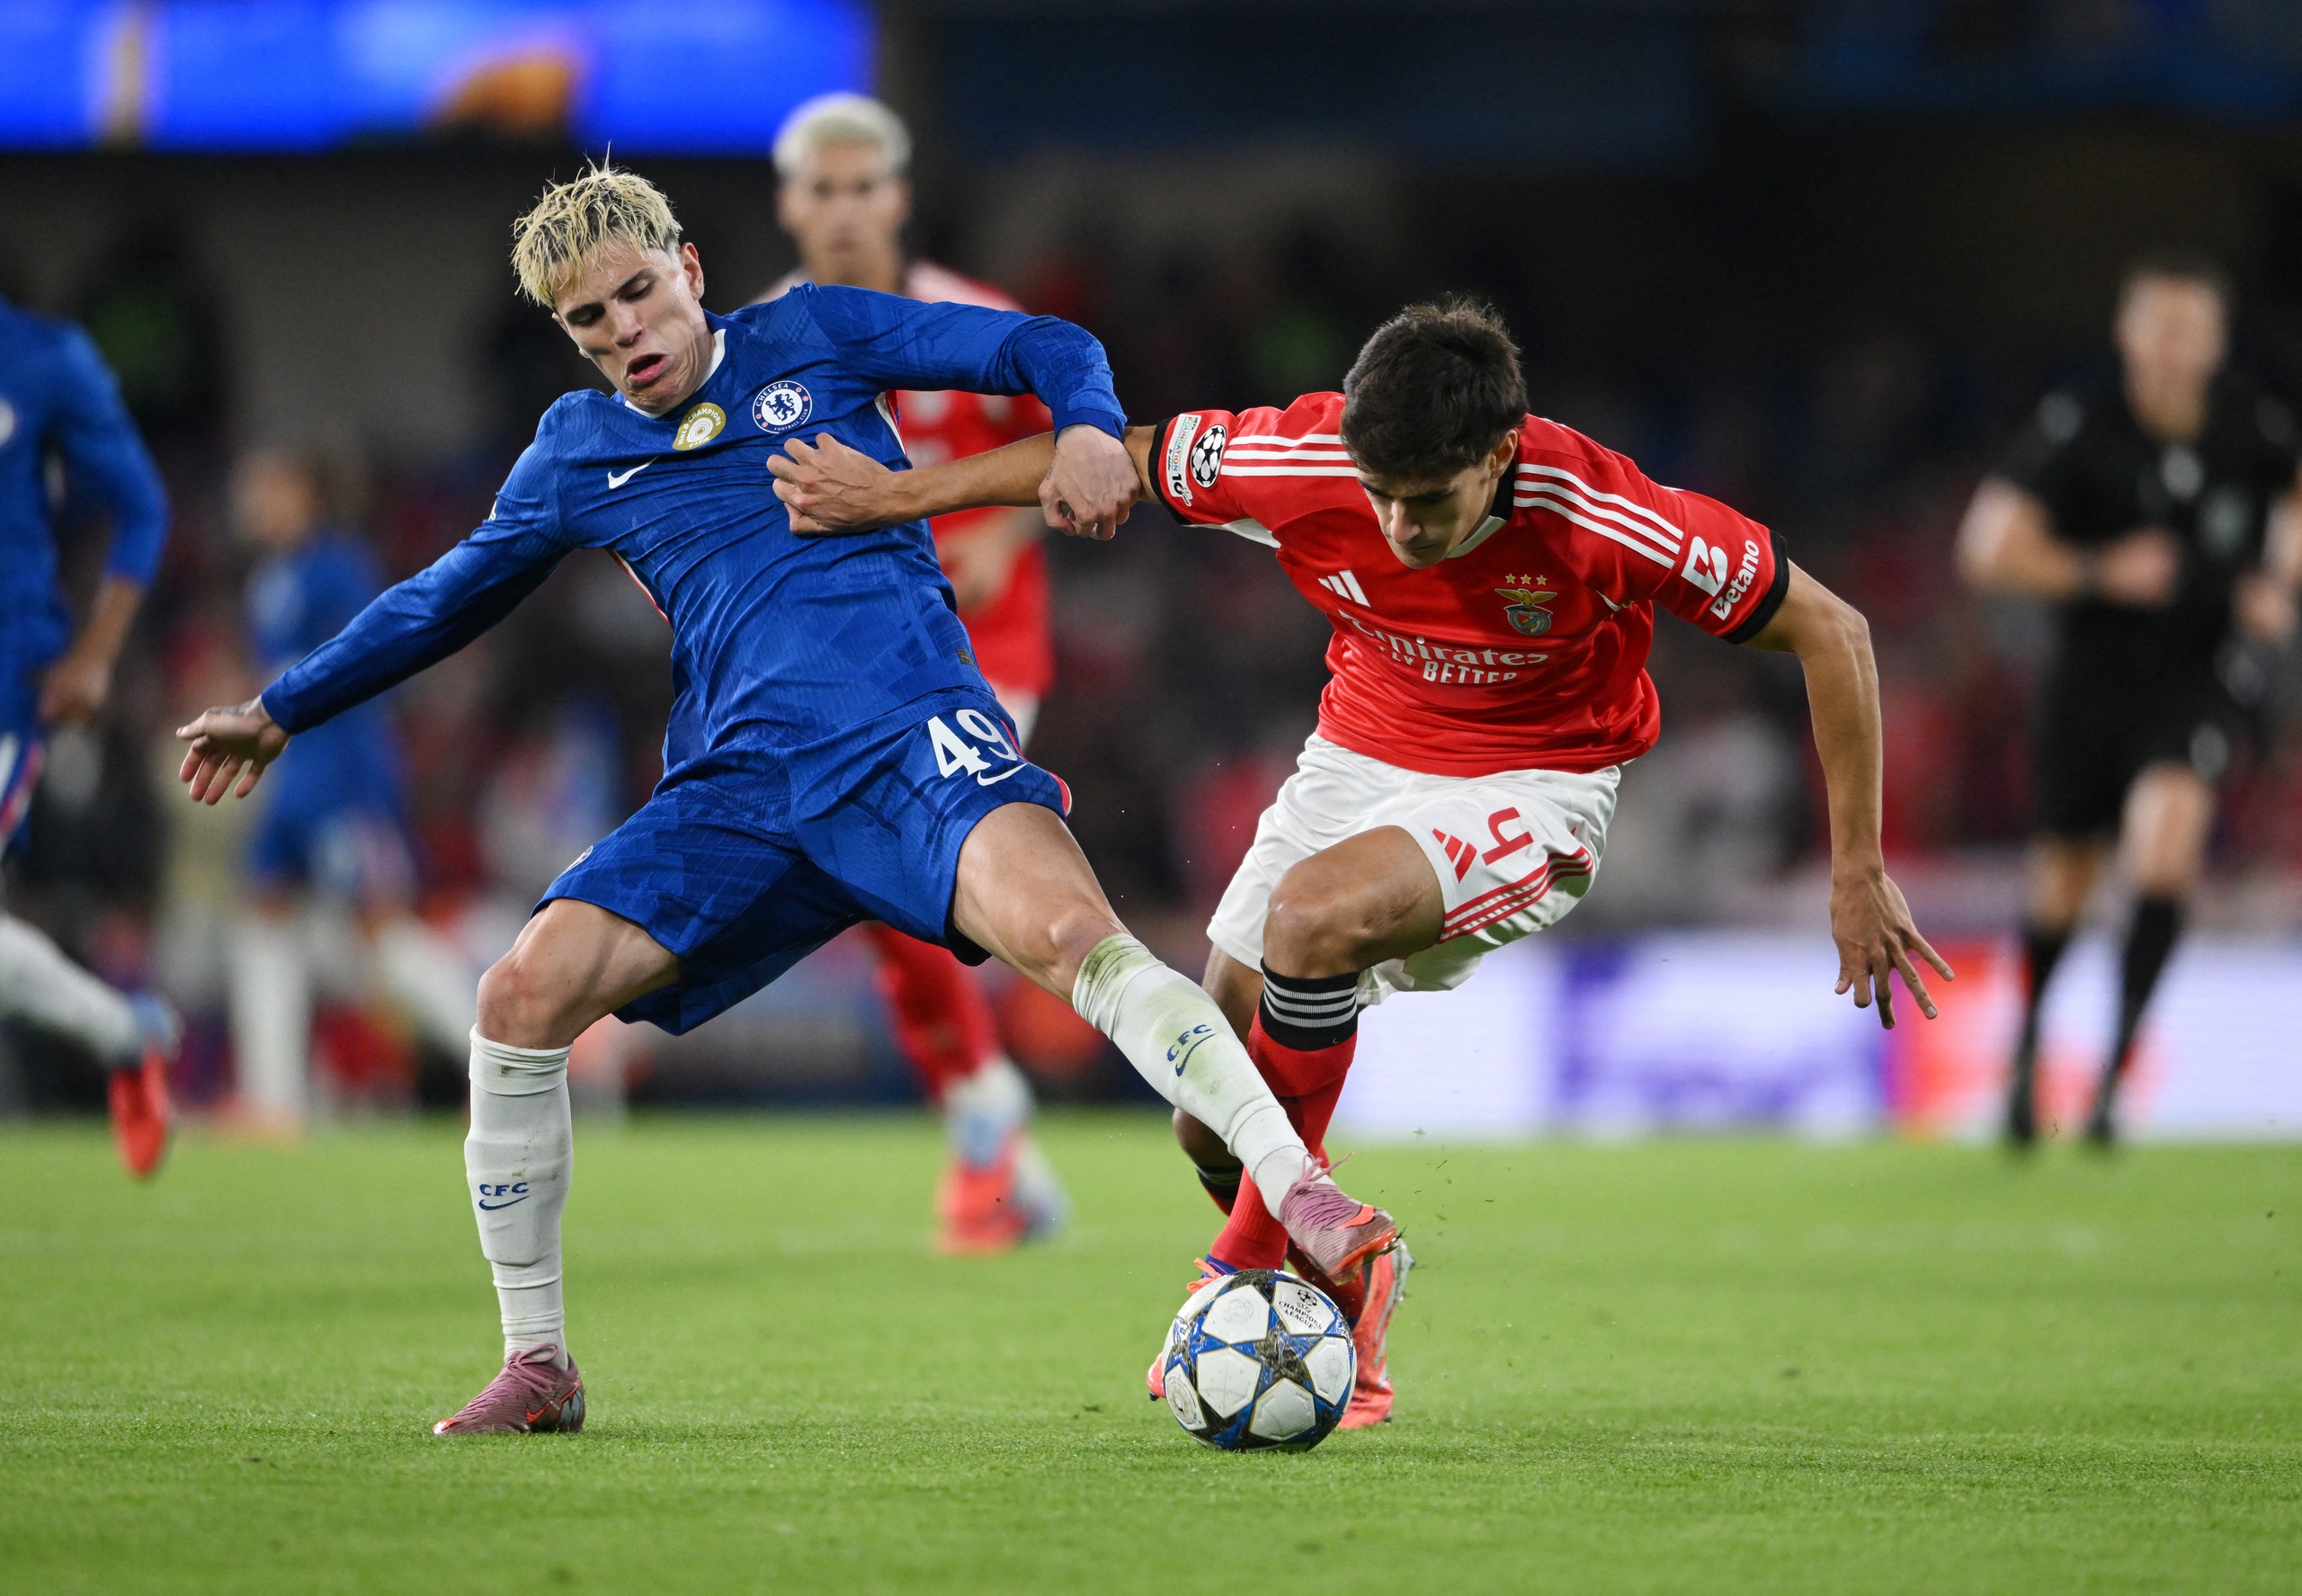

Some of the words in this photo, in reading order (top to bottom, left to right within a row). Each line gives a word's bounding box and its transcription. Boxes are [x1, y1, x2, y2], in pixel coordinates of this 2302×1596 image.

[756, 383, 789, 407] CHELSEA
[688, 407, 722, 426] CHAMPIONS
[773, 421, 799, 431] FOOTBALL
[799, 408, 808, 421] CLUB
[1173, 416, 1192, 471] FOUNDATION
[1172, 473, 1184, 495] 10
[1709, 539, 1760, 620] Betano
[927, 709, 1018, 779] 49
[1481, 807, 1534, 866] 4
[1167, 1024, 1212, 1062] CFC
[479, 1181, 530, 1197] CFC
[1278, 1301, 1322, 1330] CHAMPIONS
[1285, 1309, 1314, 1329] LEAGUE
